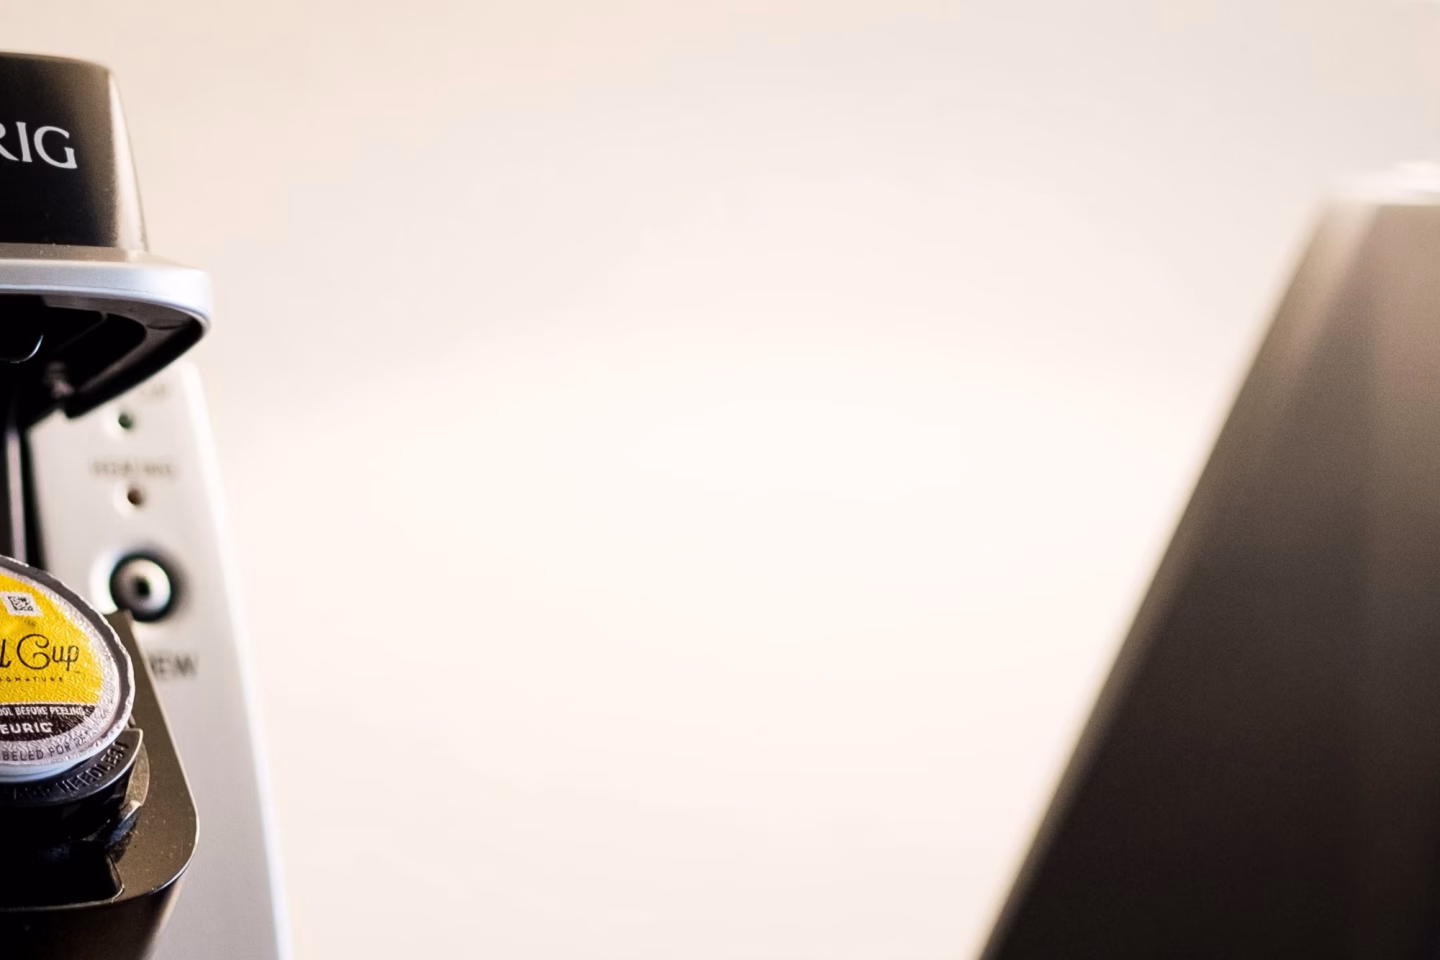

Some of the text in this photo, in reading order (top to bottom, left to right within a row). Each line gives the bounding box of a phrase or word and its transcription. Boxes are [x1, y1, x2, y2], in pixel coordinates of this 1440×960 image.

[16, 633, 80, 672] Cup
[15, 706, 48, 717] BEFORE
[48, 744, 72, 758] FOR
